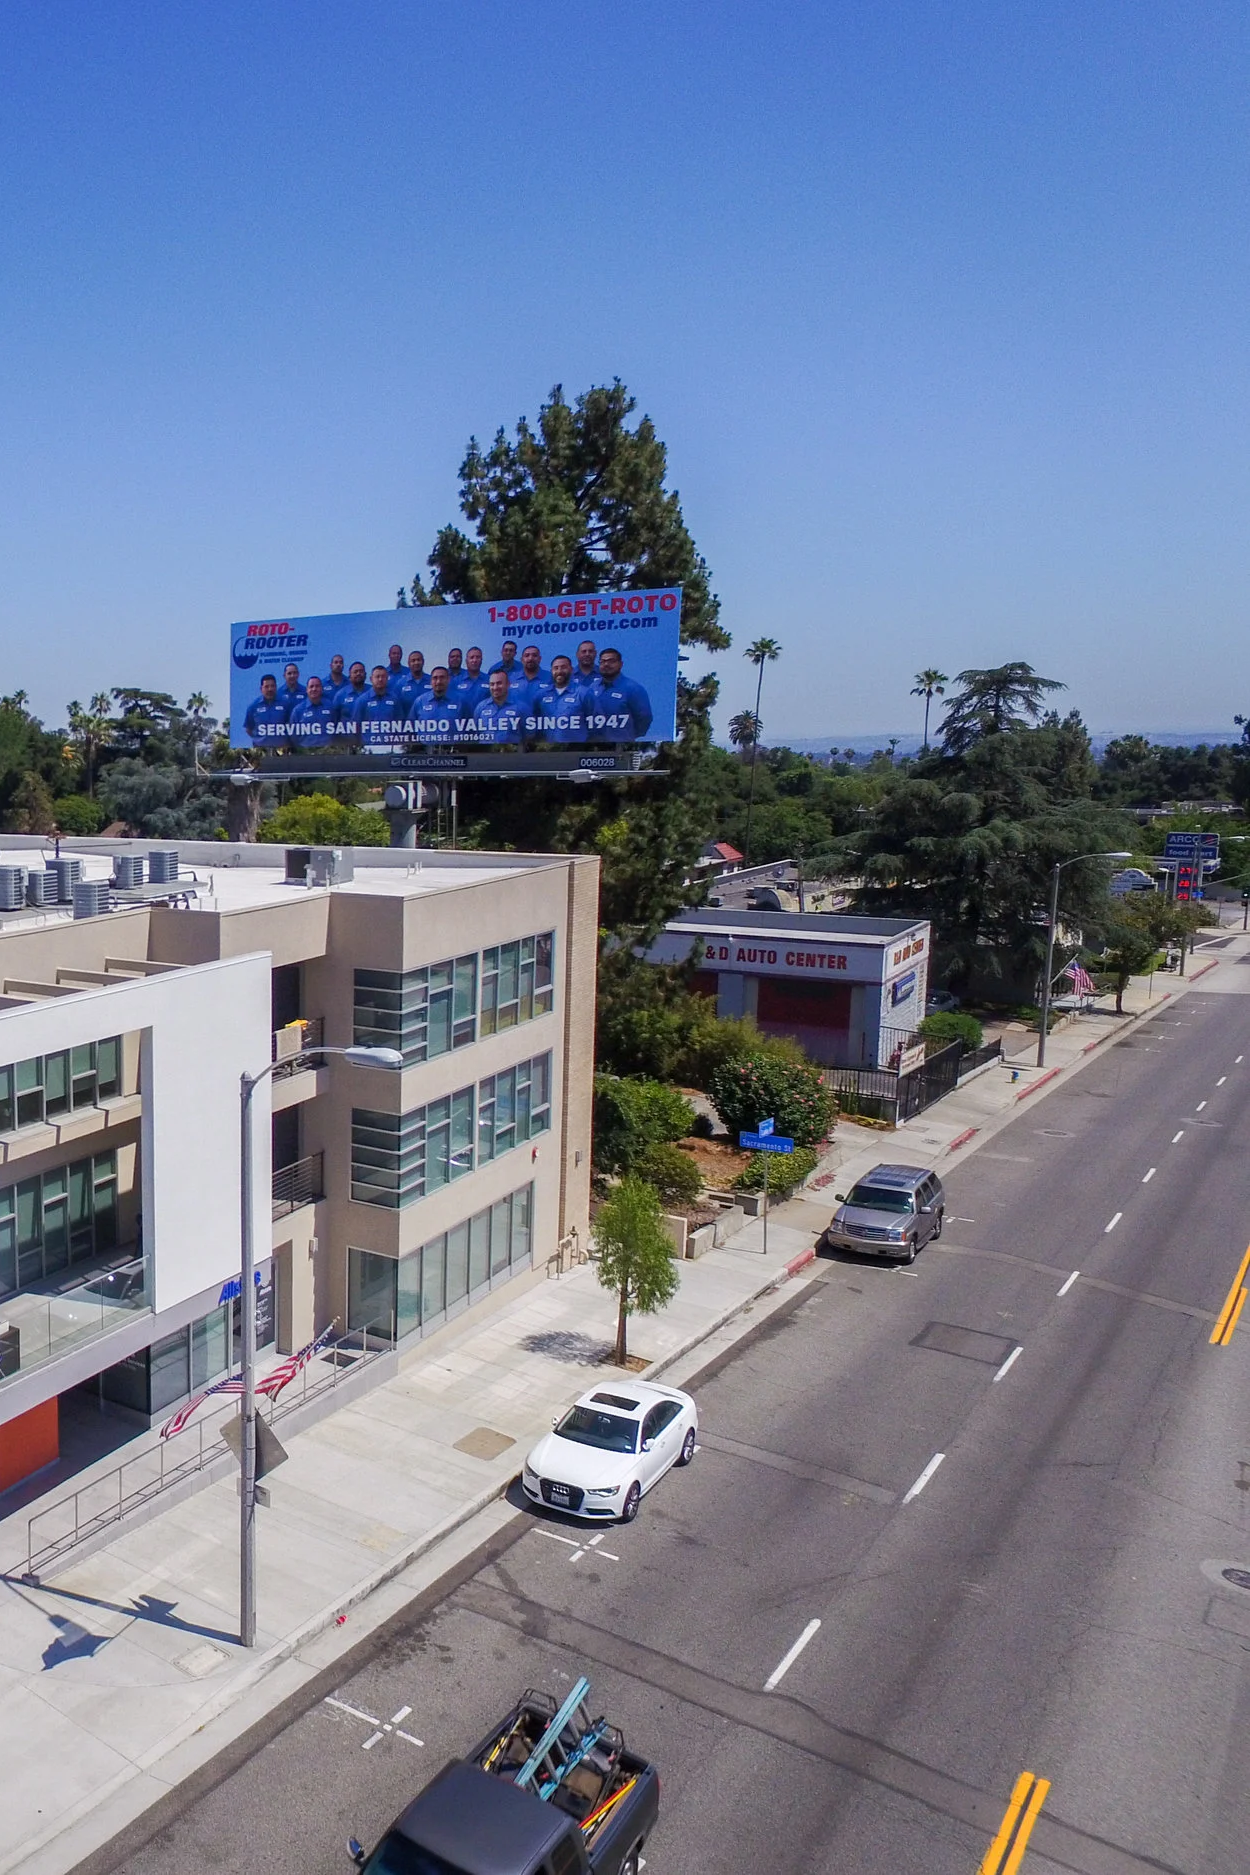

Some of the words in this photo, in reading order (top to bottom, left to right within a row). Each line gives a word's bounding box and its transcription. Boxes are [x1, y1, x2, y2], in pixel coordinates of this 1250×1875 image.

[488, 594, 677, 622] 1-800-GET-ROTO
[247, 622, 295, 636] ROTO-
[502, 616, 658, 638] myrotorooter.com
[244, 634, 309, 650] ROOTER
[258, 723, 321, 736] SERVING
[326, 721, 357, 734] SAN
[362, 719, 450, 734] FERNANDO
[455, 716, 521, 732] VALLEY
[526, 715, 580, 730] SINCE
[586, 714, 630, 729] 1947
[412, 734, 451, 742] LICENSE:
[453, 733, 494, 741] #1016021
[580, 758, 615, 767] 006028
[736, 948, 777, 964] AUTO
[786, 952, 848, 970] CENTER
[742, 1139, 781, 1150] Sacramento
